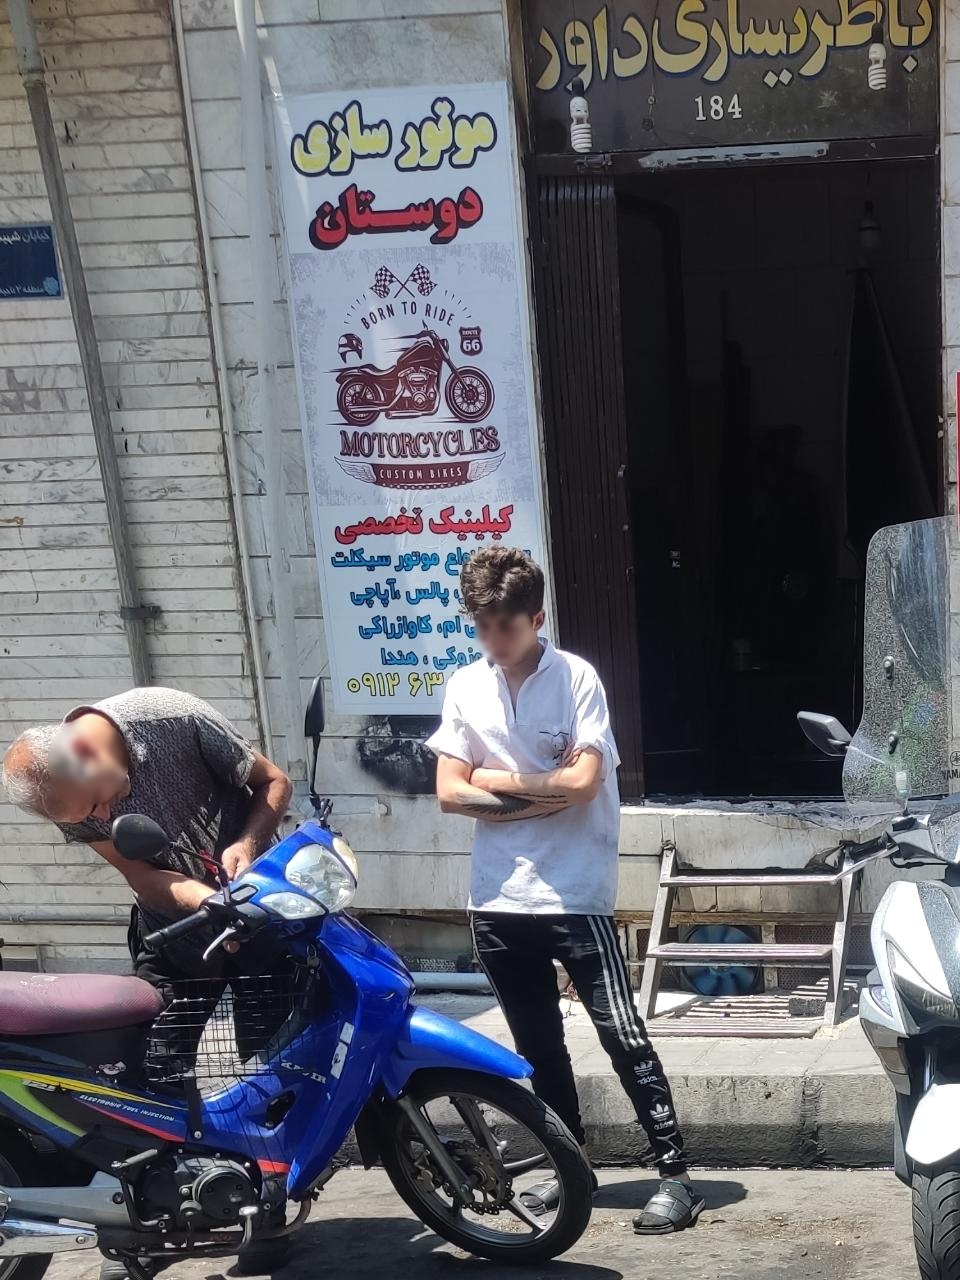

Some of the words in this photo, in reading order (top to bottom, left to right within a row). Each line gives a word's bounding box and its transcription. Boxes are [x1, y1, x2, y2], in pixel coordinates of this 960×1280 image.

[535, 5, 649, 92] داور
[694, 93, 743, 121] 184
[291, 100, 392, 177] سازی
[395, 97, 497, 171] موتور
[309, 183, 484, 250] دوستان
[360, 304, 395, 330] BORN
[401, 301, 417, 315] TO
[425, 303, 455, 327] RIDE
[462, 340, 480, 352] 66
[339, 425, 501, 458] MOTORCYCLES
[380, 469, 423, 480] CUSTOM
[430, 467, 463, 479] BIKES
[335, 507, 424, 544] تخصصی
[429, 504, 514, 541] کیلینیک
[331, 548, 391, 571] سیکلت
[394, 551, 440, 571] موتور
[406, 582, 449, 606] پالس
[381, 648, 419, 665] هندا
[347, 672, 400, 697] ۰۹۱۲
[407, 672, 446, 697] ۶۳
[80, 1094, 121, 1109] ELECTRONIC
[122, 1105, 139, 1113] FUEL
[140, 1110, 175, 1121] INJECTION
